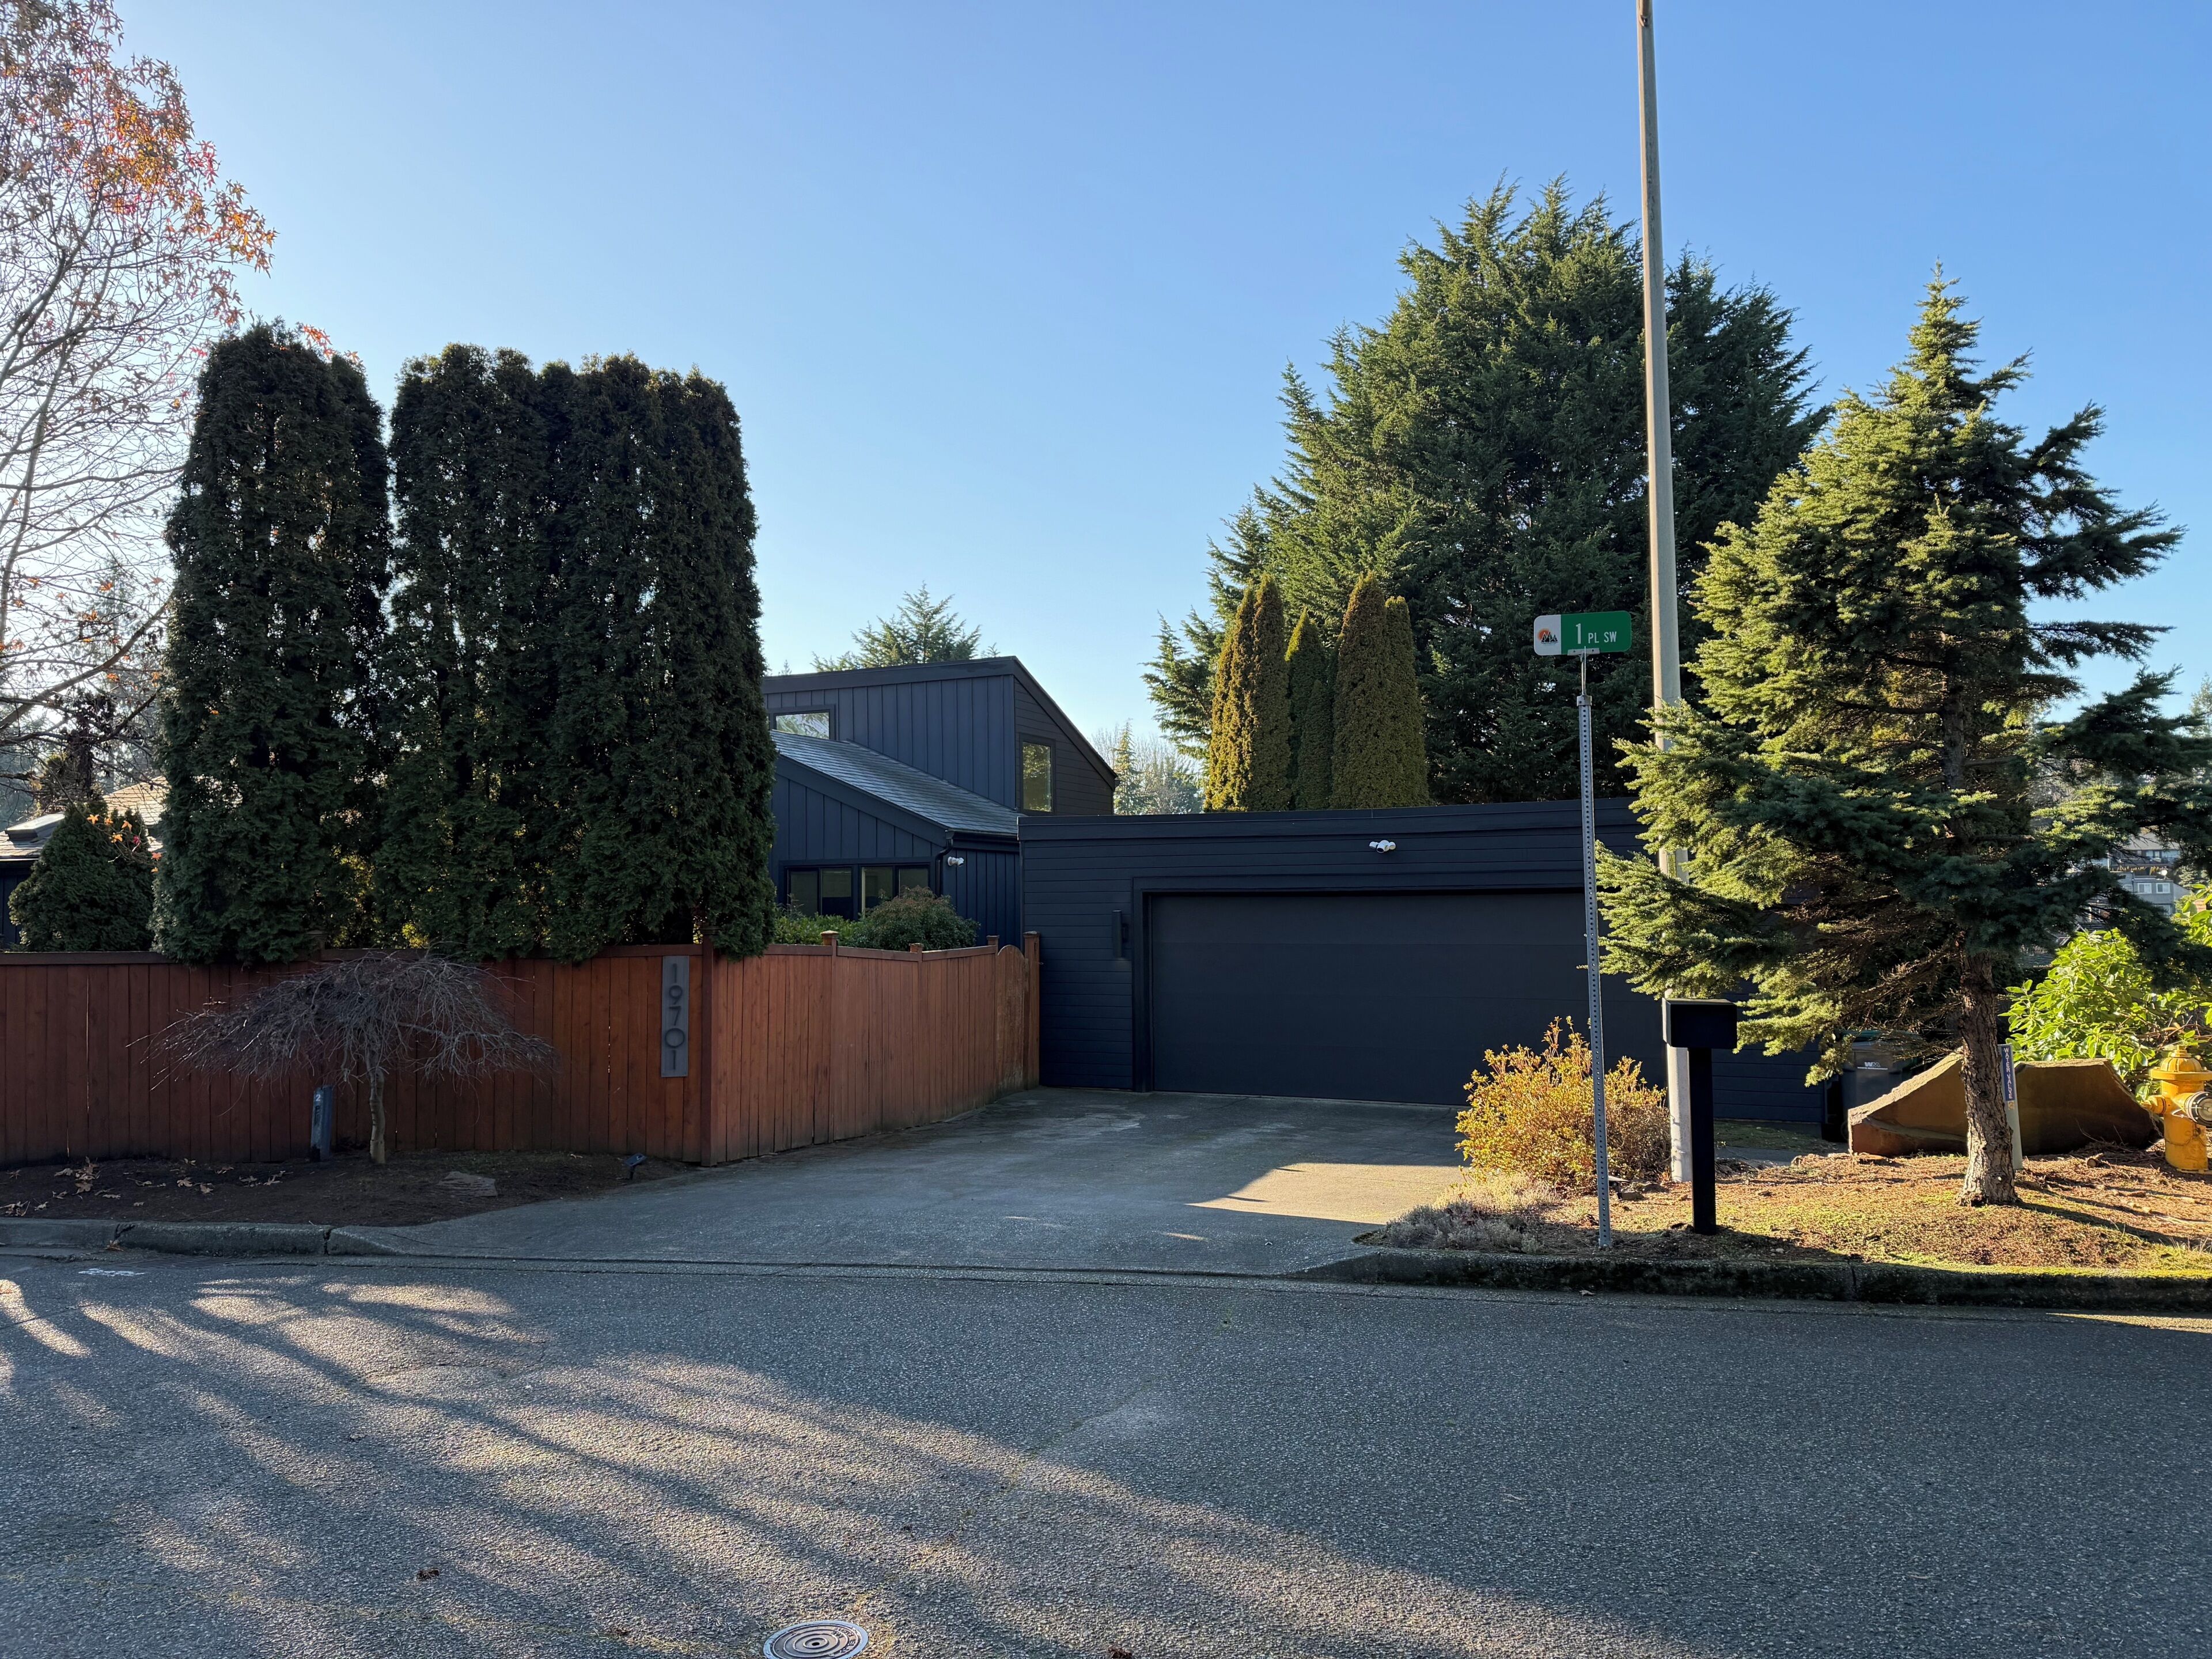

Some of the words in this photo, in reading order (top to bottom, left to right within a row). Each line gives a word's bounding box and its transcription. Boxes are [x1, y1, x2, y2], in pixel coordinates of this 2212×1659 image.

[1576, 623, 1581, 644] 1
[1588, 632, 1599, 643] PL
[1604, 631, 1617, 643] SW
[665, 963, 685, 1070] 19701
